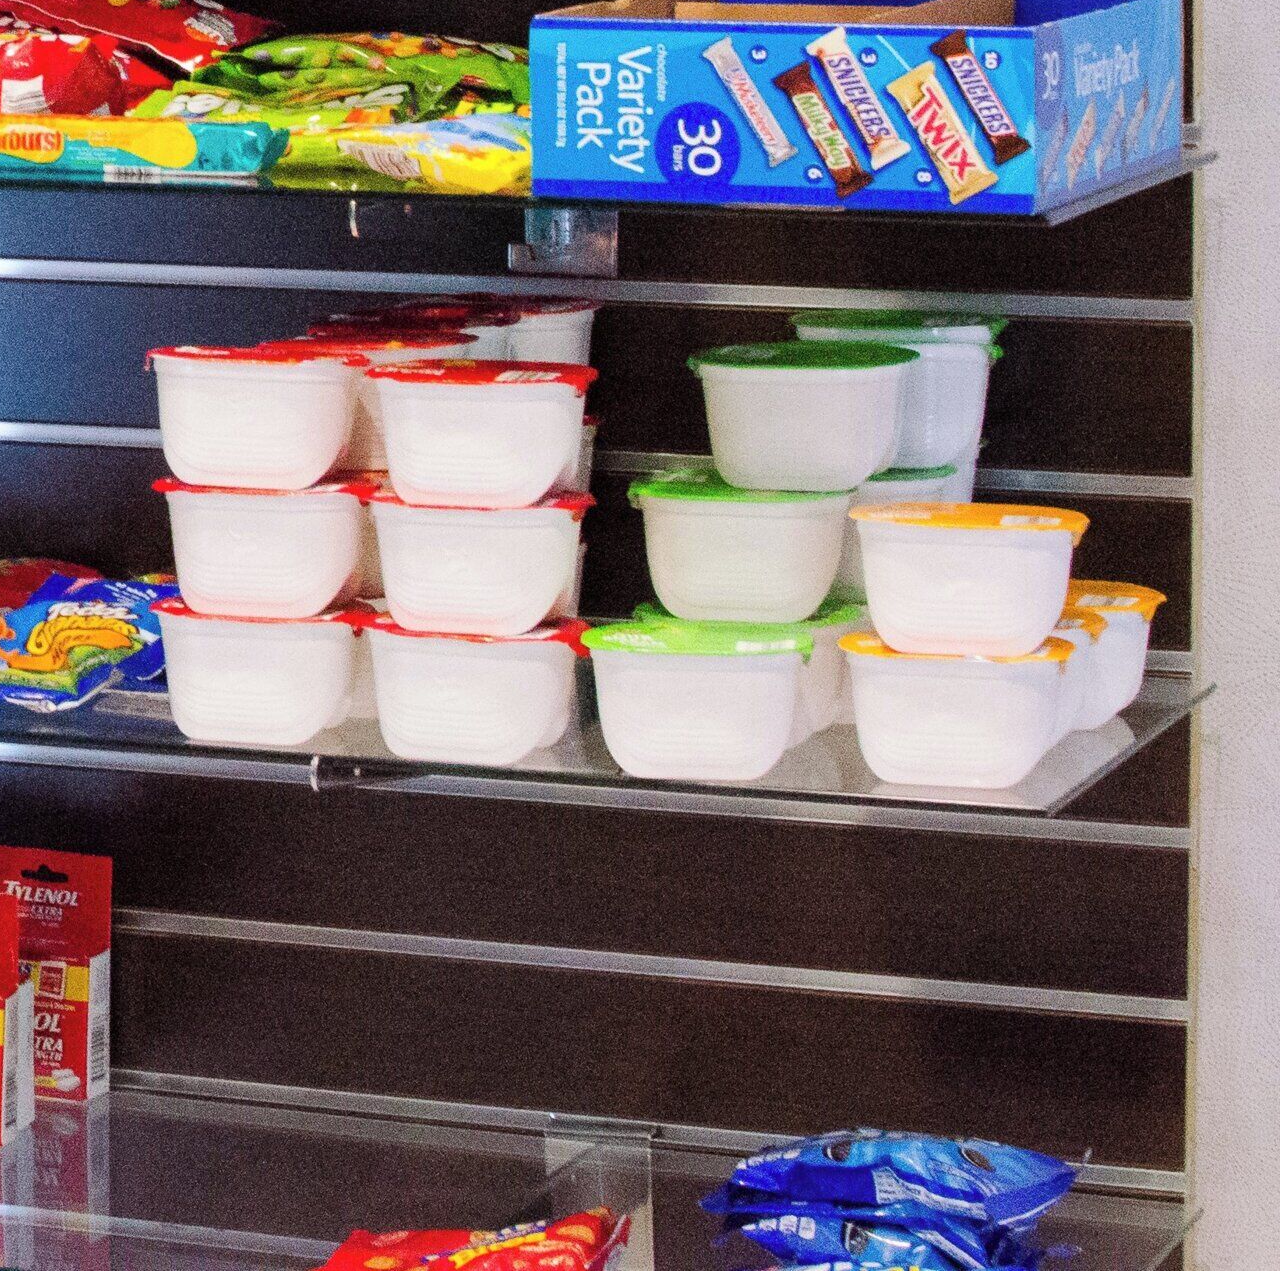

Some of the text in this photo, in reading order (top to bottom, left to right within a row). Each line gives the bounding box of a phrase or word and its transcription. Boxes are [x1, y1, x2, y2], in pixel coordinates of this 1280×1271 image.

[751, 47, 767, 61] 3
[861, 52, 876, 64] 3
[984, 52, 998, 70] 10
[575, 62, 615, 150] Pack
[609, 45, 655, 175] Variety
[825, 55, 892, 139] SNICKERS
[950, 56, 1010, 134] SNICKERS
[676, 117, 723, 177] 30
[910, 82, 977, 182] TWIX
[671, 143, 686, 172] bars
[916, 171, 933, 182] 8
[3, 879, 82, 908] TYLENOL
